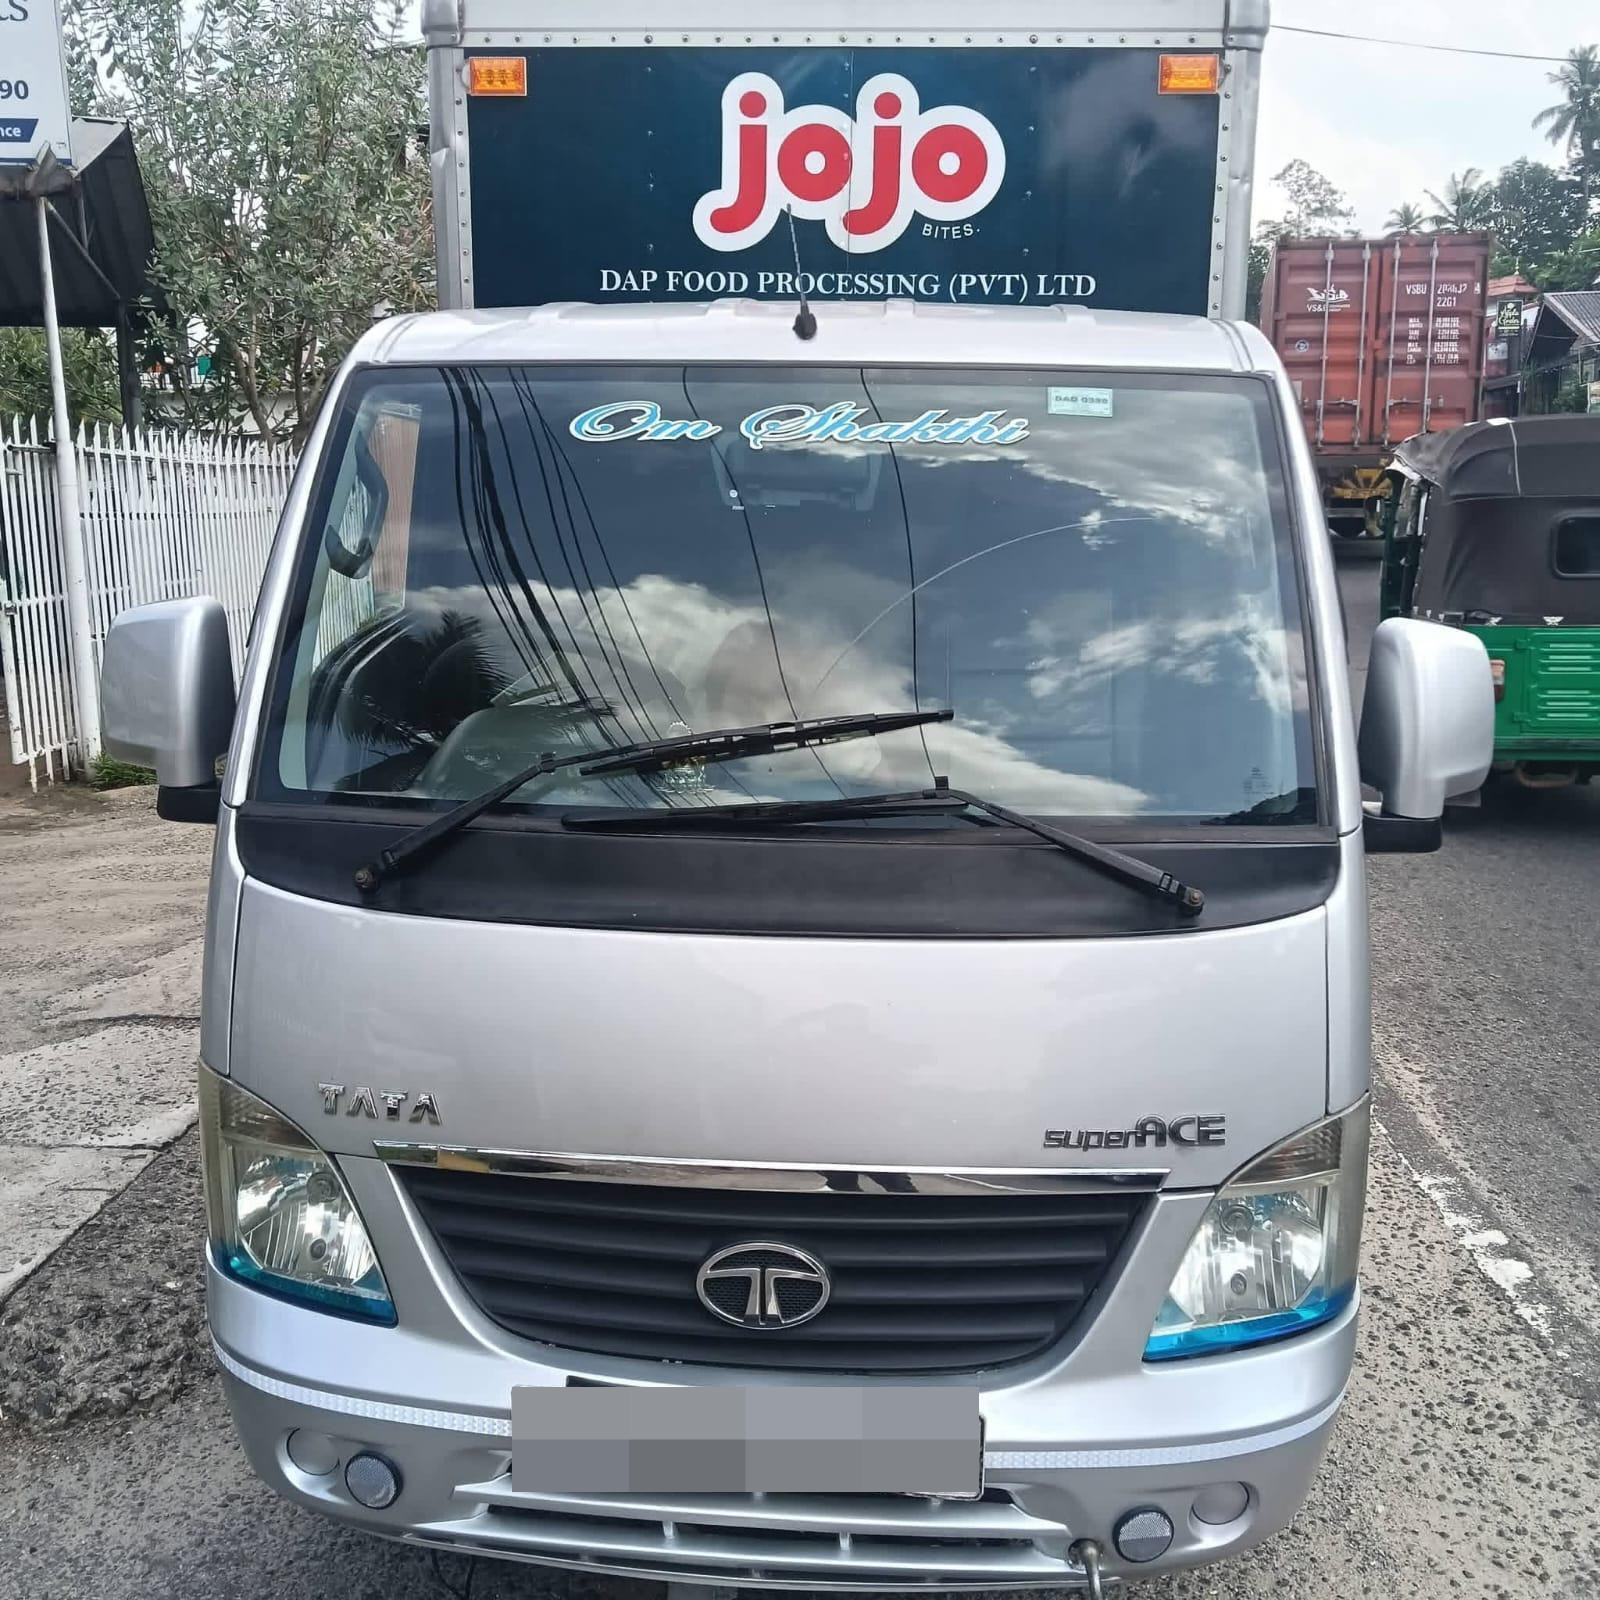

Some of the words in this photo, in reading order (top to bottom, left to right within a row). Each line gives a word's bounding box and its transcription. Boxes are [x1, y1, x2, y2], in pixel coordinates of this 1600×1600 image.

[702, 82, 996, 244] jojo
[599, 269, 658, 292] DAP
[666, 270, 749, 293] FOOD
[757, 271, 941, 296] PROCESSING
[949, 273, 1029, 303] (PVT)
[1036, 274, 1097, 297] LTD
[1437, 296, 1457, 307] 22G1
[569, 400, 722, 442] Om
[740, 400, 1030, 450] Shakthi
[318, 1082, 442, 1126] TATA
[1043, 1114, 1226, 1152] superACE
